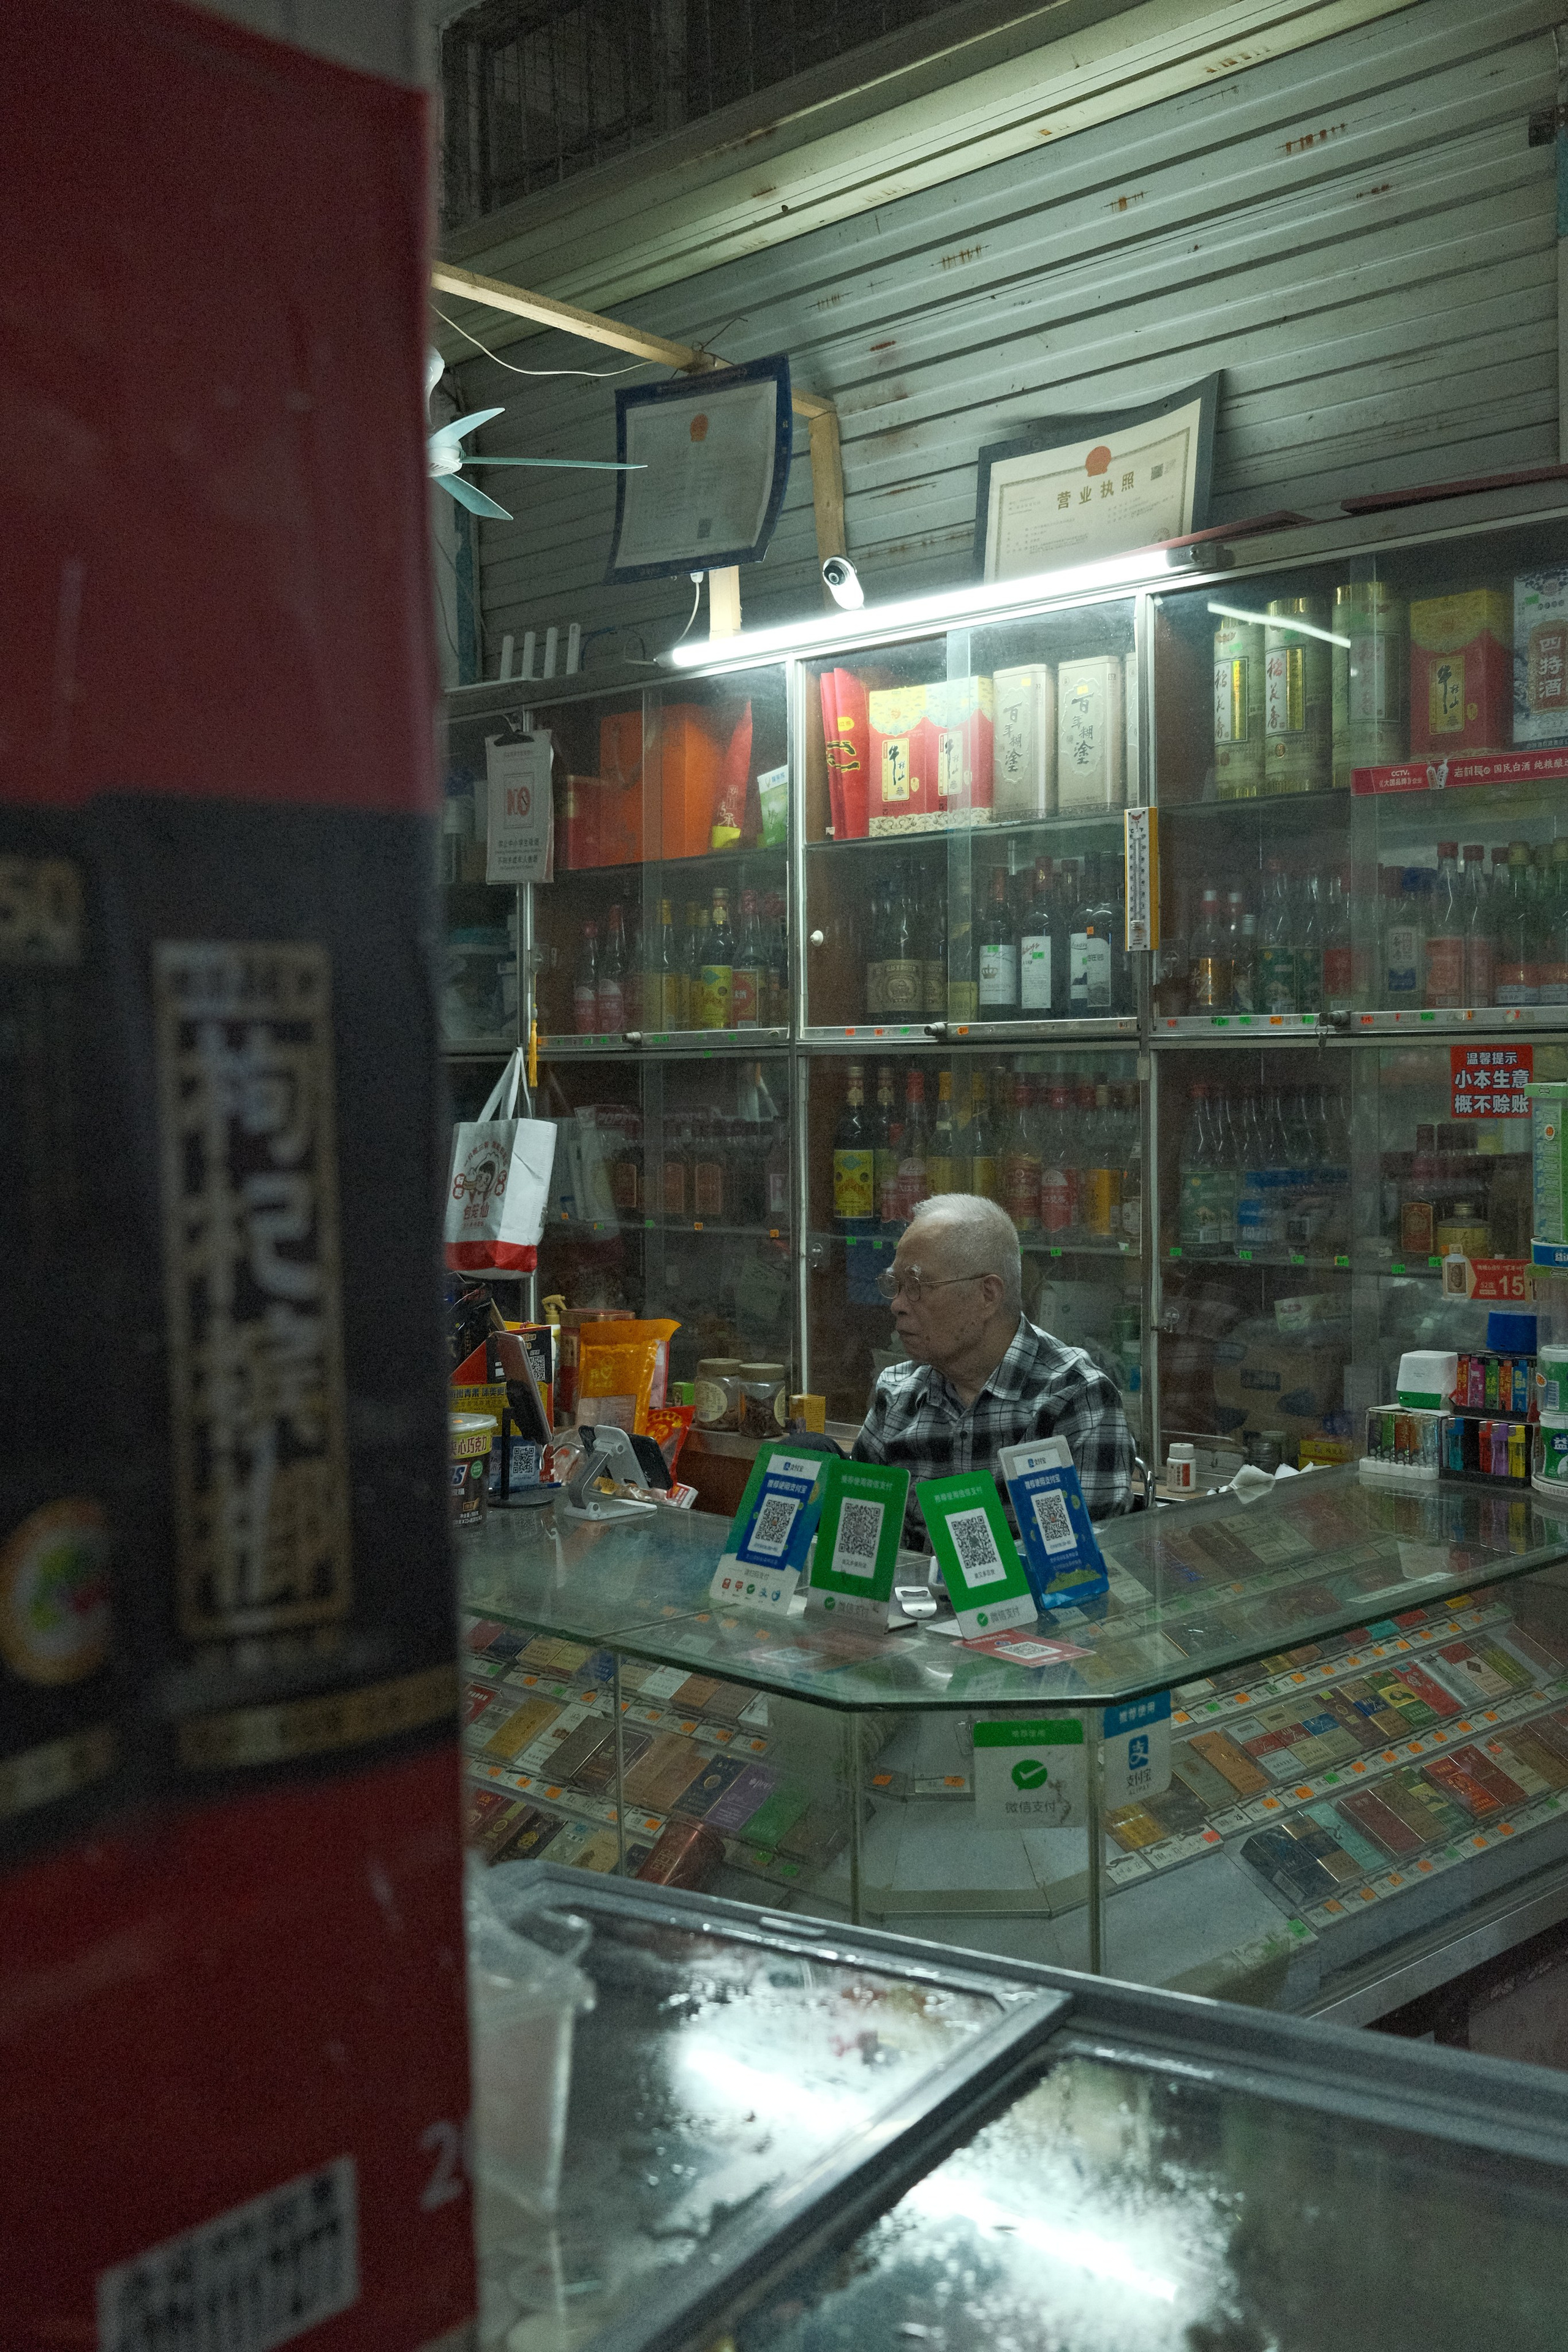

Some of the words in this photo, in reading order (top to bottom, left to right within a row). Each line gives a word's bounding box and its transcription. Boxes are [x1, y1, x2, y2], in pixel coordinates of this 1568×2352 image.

[1057, 472, 1134, 510] 营业执照
[1539, 637, 1562, 699] 四特酒
[1466, 1052, 1518, 1065] 温馨提示
[1455, 1069, 1530, 1089] 小本生意
[1455, 1094, 1529, 1114] 概不赊账
[1499, 1275, 1525, 1295] 15
[990, 1607, 1020, 1624] 微信支付
[1126, 1768, 1152, 1790] 支付宝
[1005, 1801, 1056, 1814] 微信支付
